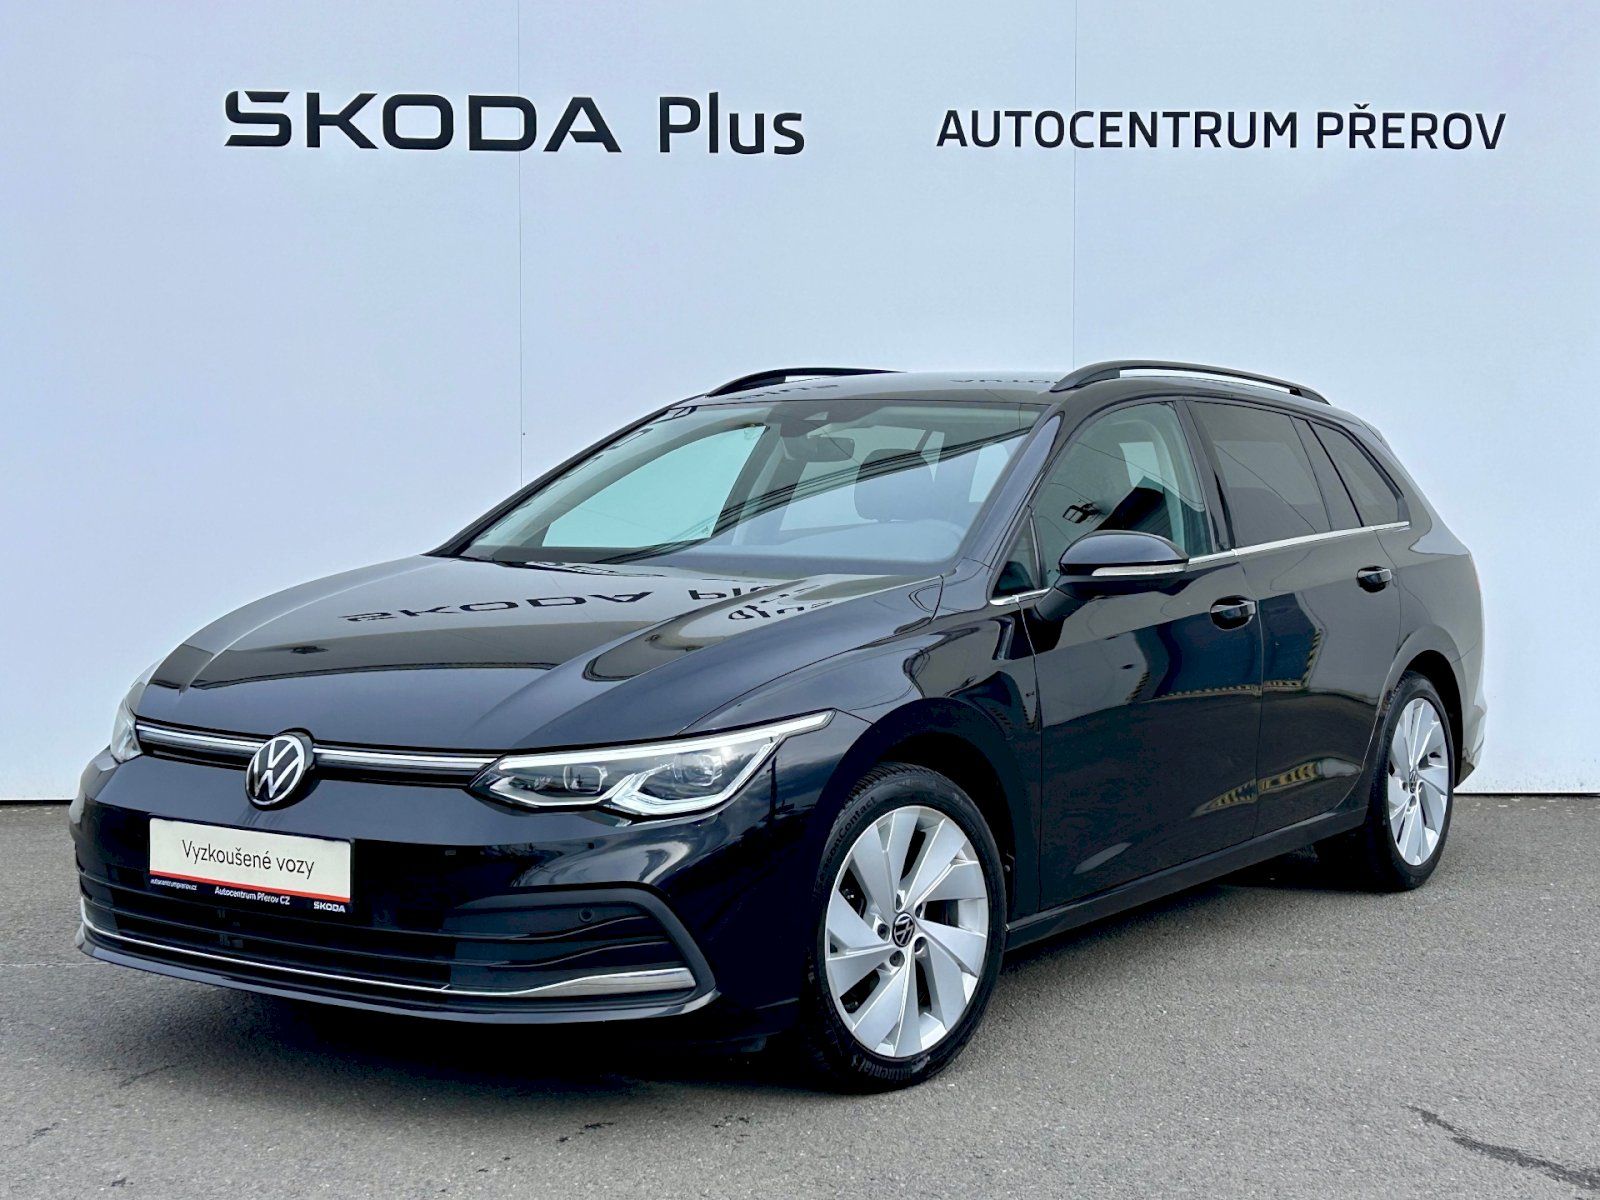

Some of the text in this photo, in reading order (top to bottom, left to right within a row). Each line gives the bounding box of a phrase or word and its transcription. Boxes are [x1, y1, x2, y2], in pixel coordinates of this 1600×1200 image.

[659, 91, 805, 155] Plus
[937, 104, 1507, 150] AUTOCENTRUM PŘEROV
[181, 839, 315, 880] Vyzkoušené vozy
[214, 885, 256, 900] Autocentrum
[279, 895, 291, 905] CZ
